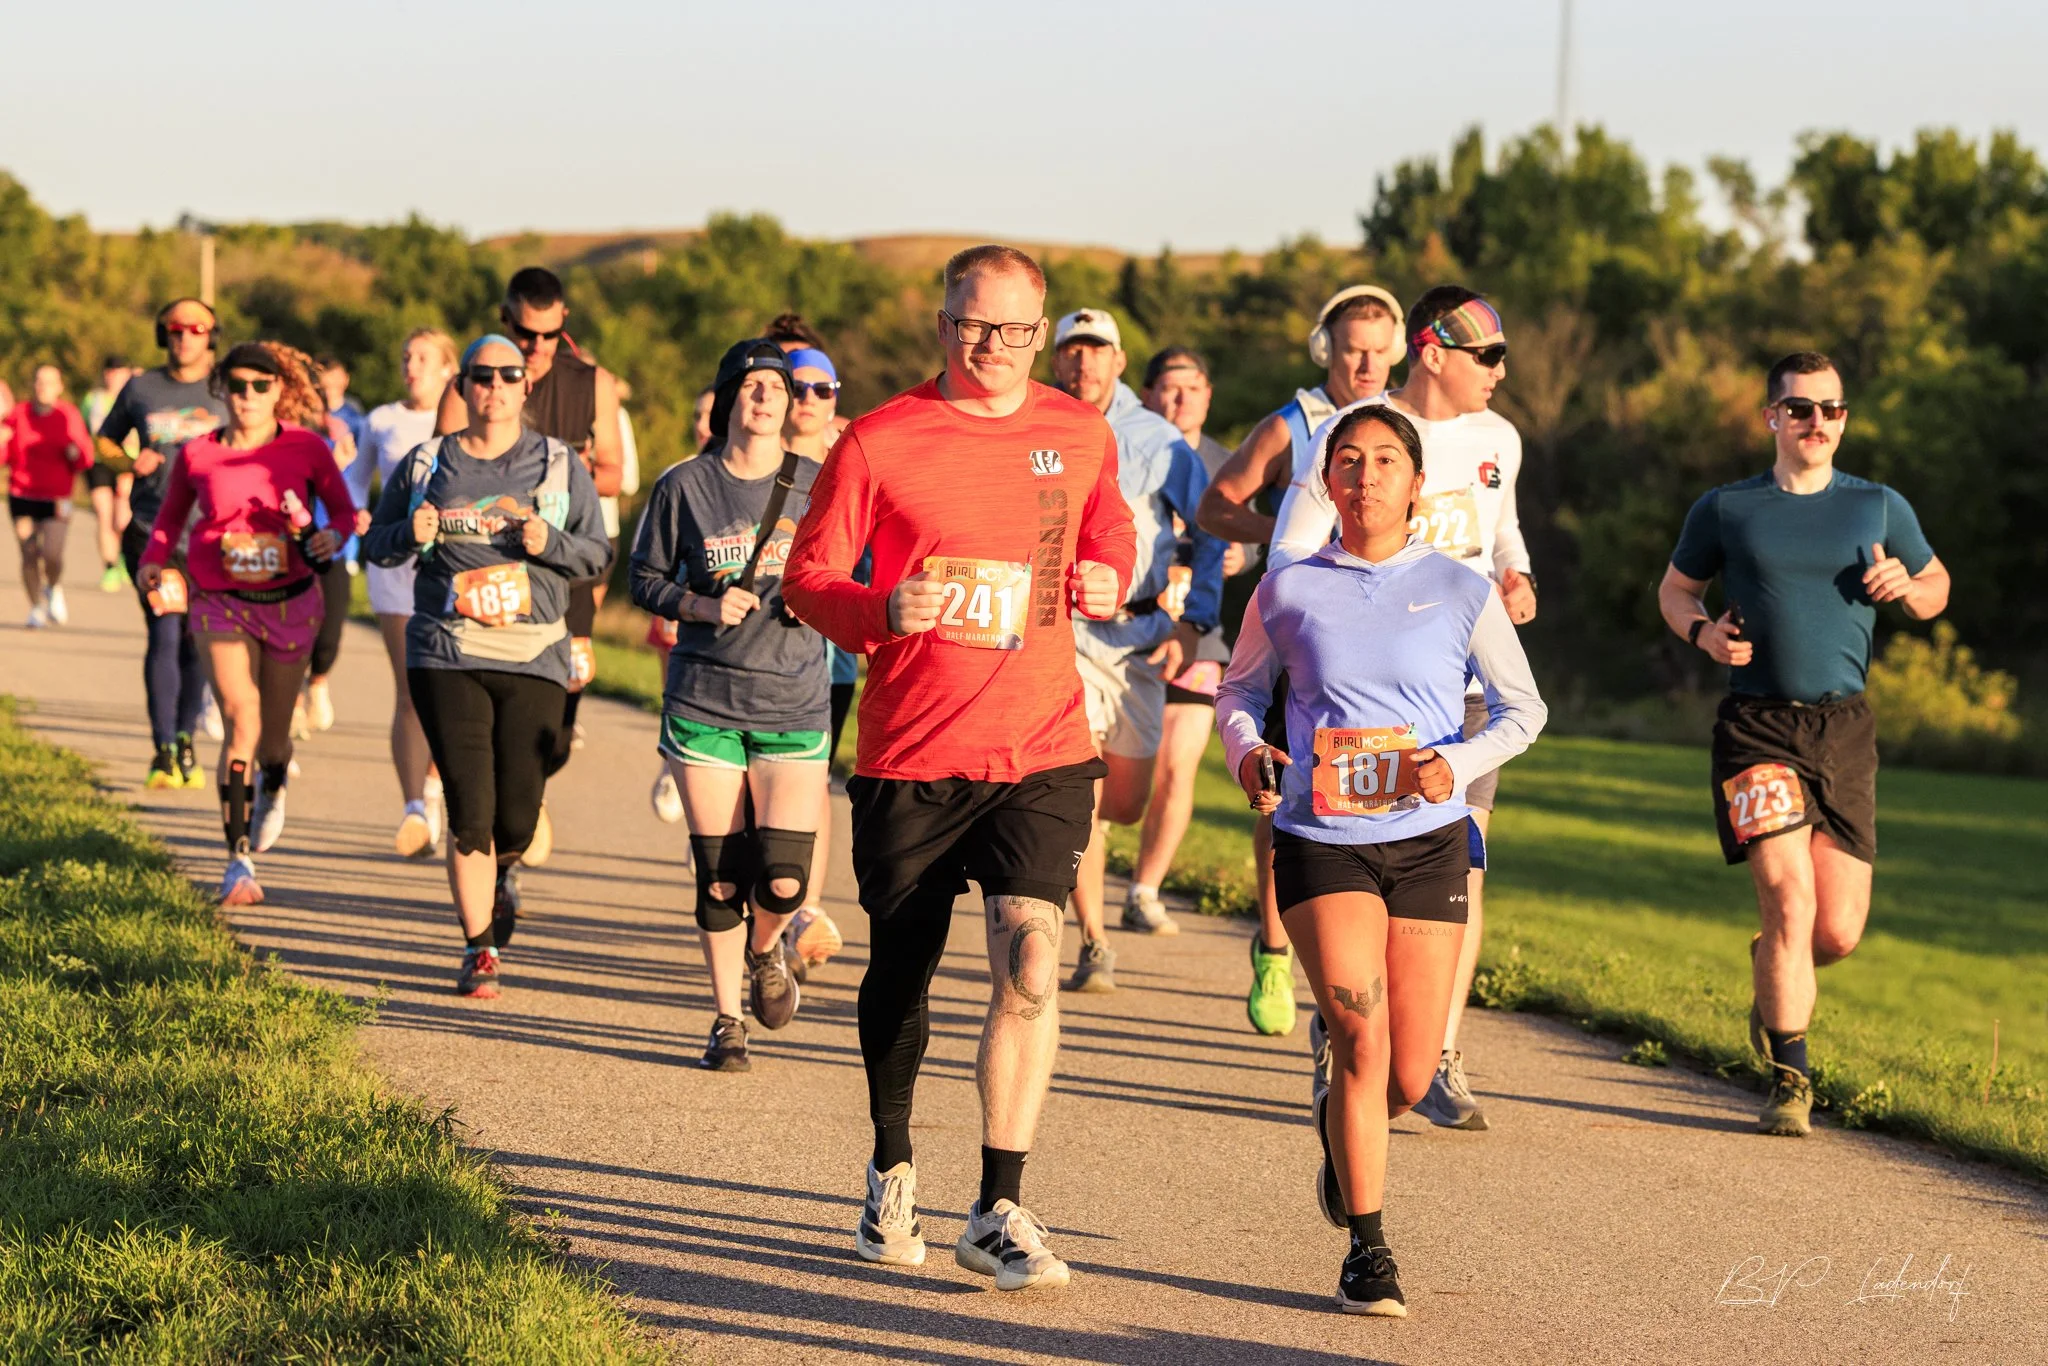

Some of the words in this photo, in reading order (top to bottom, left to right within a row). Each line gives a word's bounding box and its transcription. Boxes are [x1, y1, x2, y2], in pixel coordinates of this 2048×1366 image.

[1409, 509, 1471, 548] 222
[229, 547, 280, 572] 256
[1037, 488, 1068, 626] BENGALS
[465, 581, 521, 618] 185
[941, 581, 1014, 630] 241
[946, 631, 963, 640] HALF
[1331, 749, 1400, 796] 187
[1337, 800, 1356, 809] HALF
[1733, 780, 1793, 827] 223
